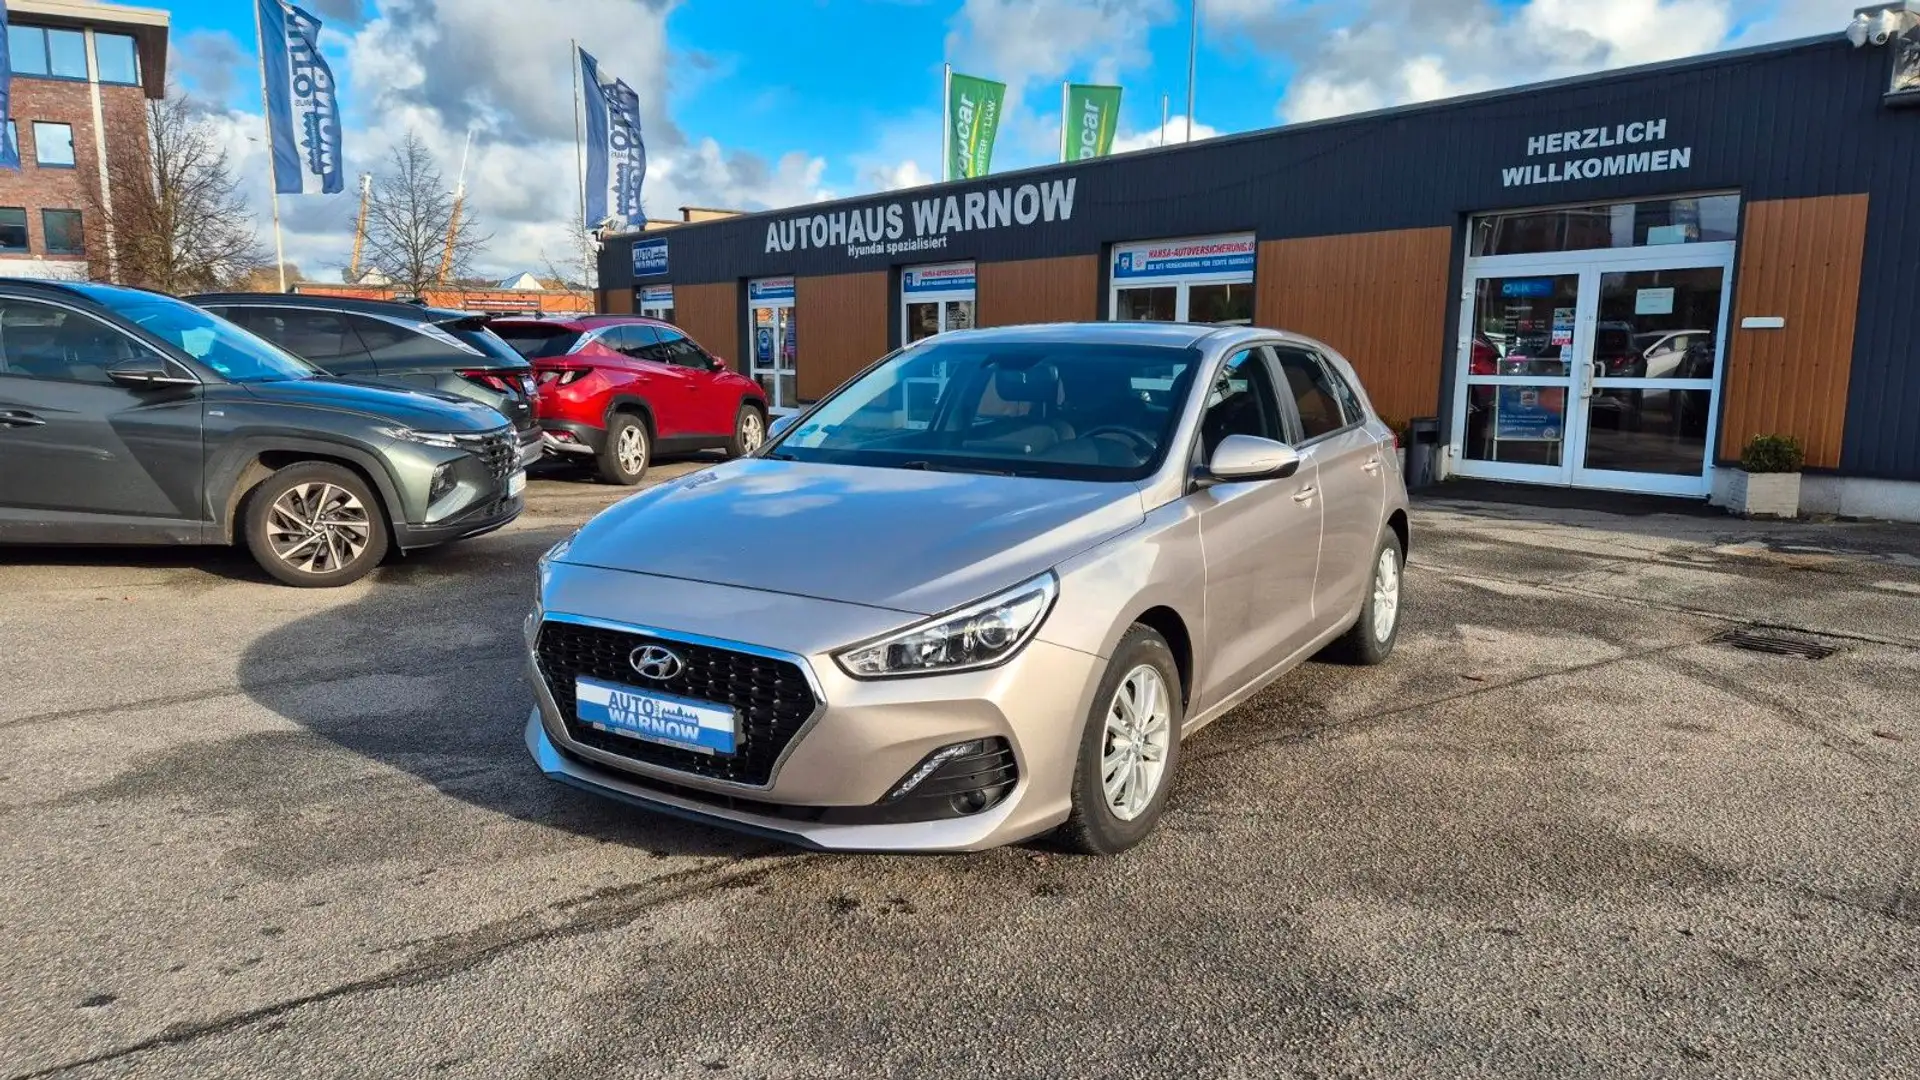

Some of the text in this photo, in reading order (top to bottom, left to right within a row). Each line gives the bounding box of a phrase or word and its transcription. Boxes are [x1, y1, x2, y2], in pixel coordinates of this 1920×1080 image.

[1527, 118, 1667, 156] HERZLICH
[1502, 147, 1692, 187] WILLKOMMEN
[764, 177, 1077, 253] AUTOHAUS WARNOW
[848, 236, 948, 258] Hyundai spezialisiert
[608, 691, 654, 717] AUTO
[608, 708, 700, 741] WARNOW
